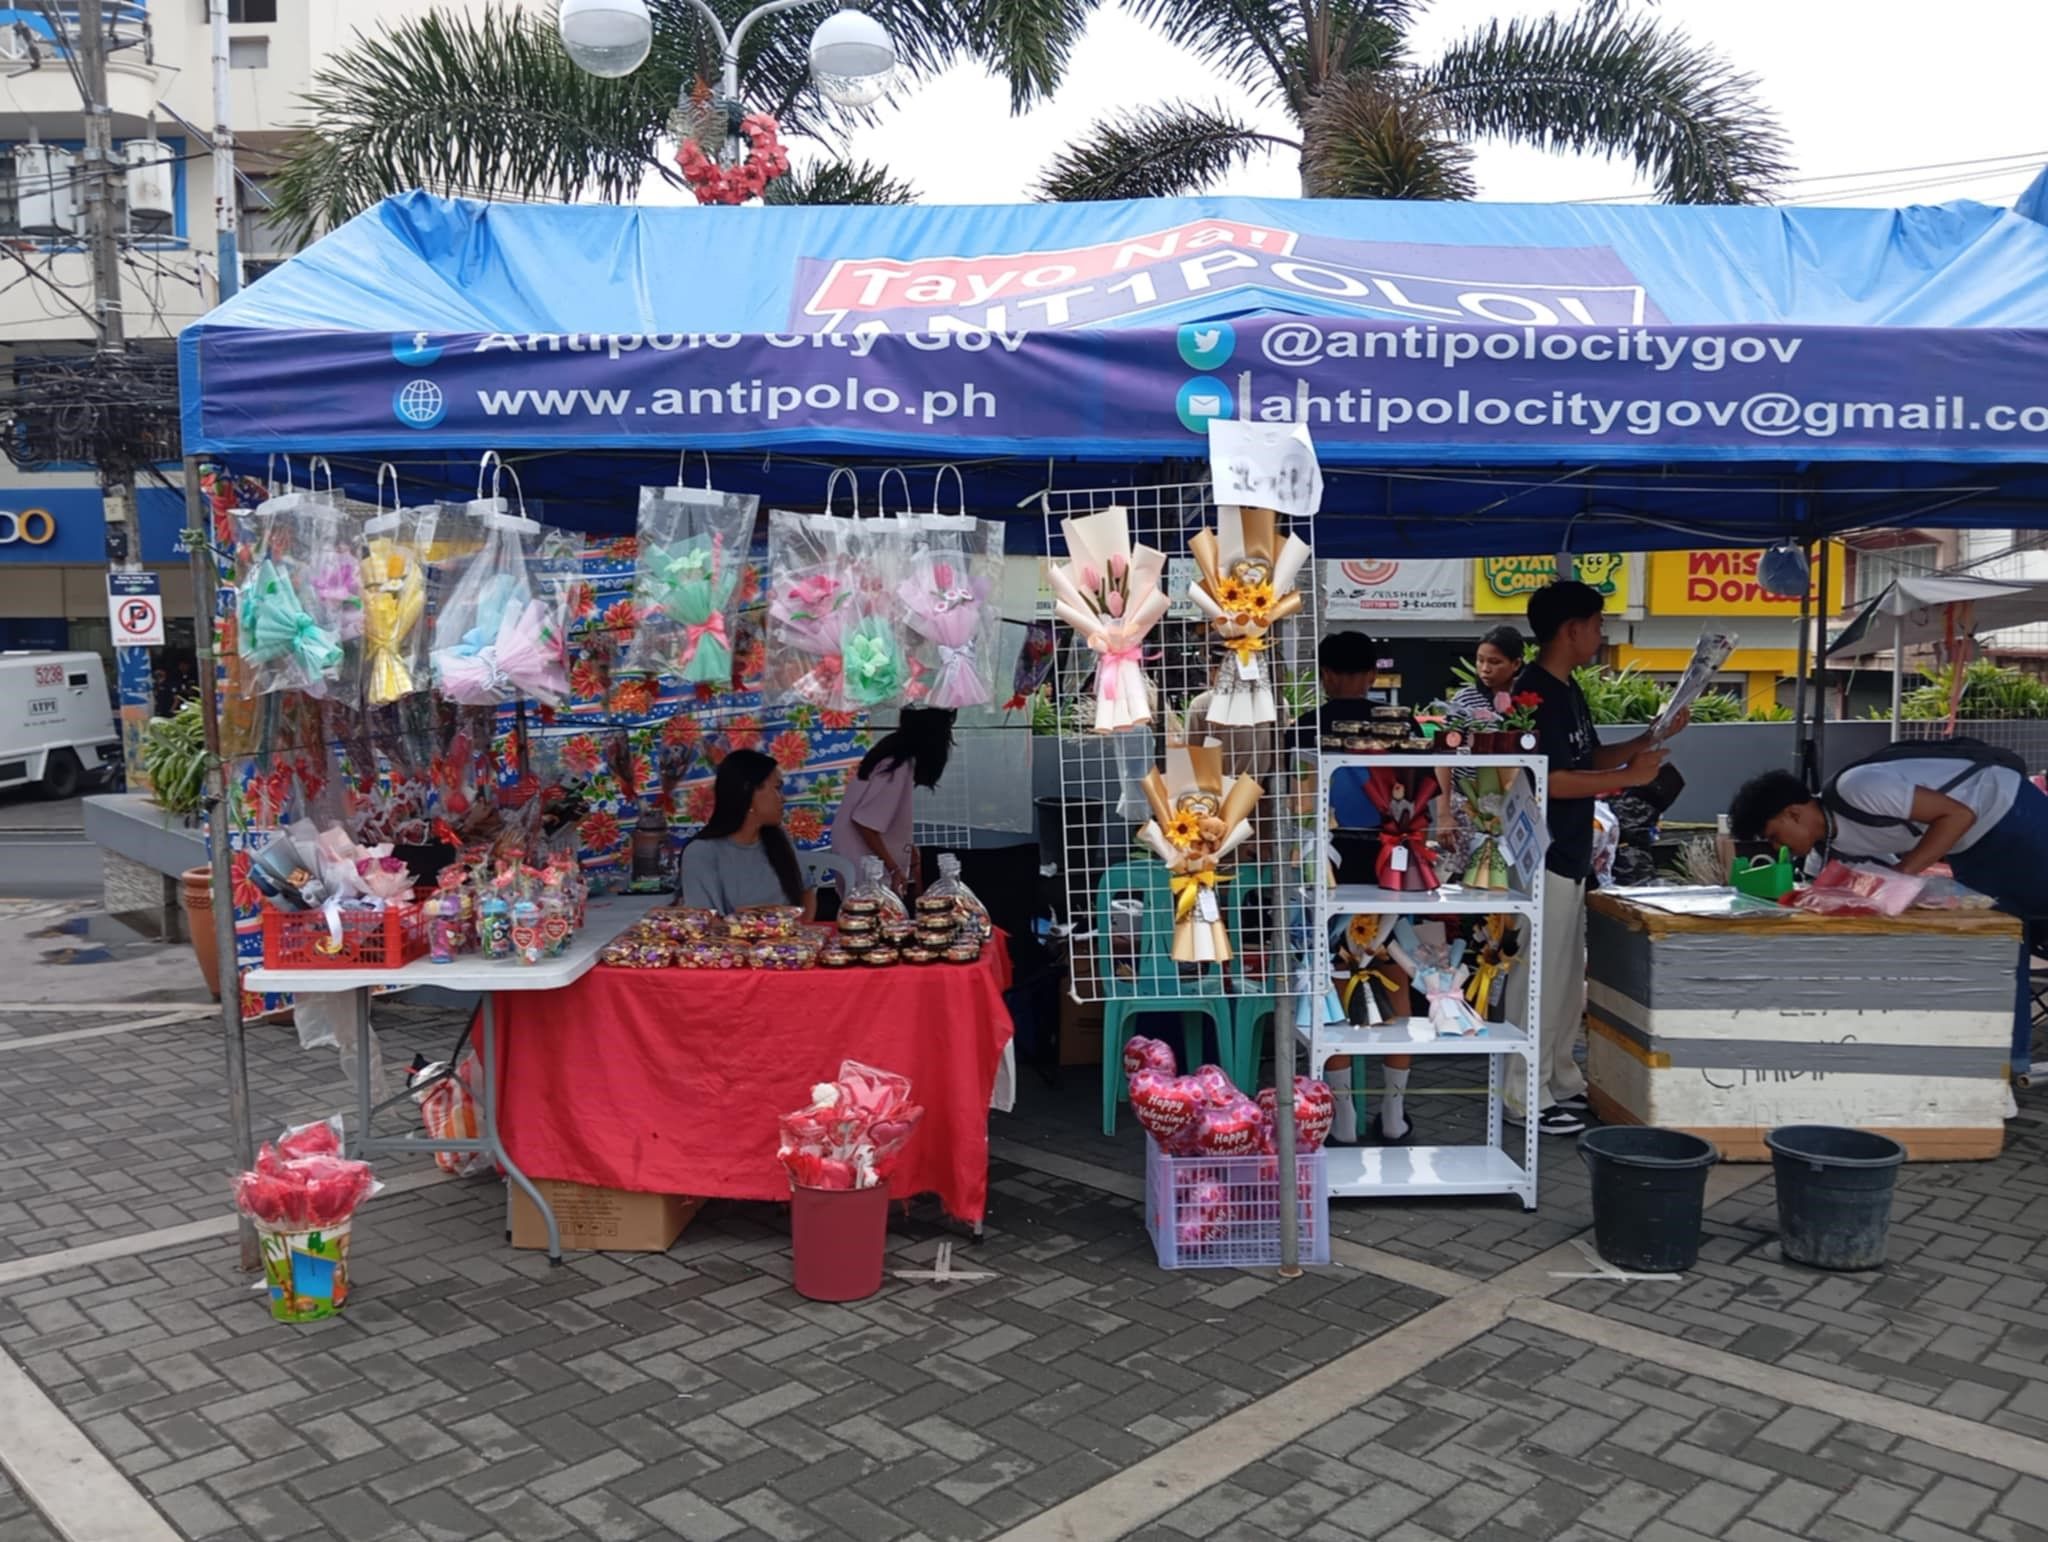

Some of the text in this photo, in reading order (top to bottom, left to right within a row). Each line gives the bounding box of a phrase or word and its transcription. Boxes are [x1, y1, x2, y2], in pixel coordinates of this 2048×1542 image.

[853, 226, 1267, 308] Tayo Na!
[1261, 323, 1802, 371] @antipolocitygov
[477, 377, 996, 424] www.antipolo.ph
[1688, 576, 1820, 603] Don
[1147, 1095, 1185, 1113] Happy
[1213, 1130, 1249, 1145] Happy
